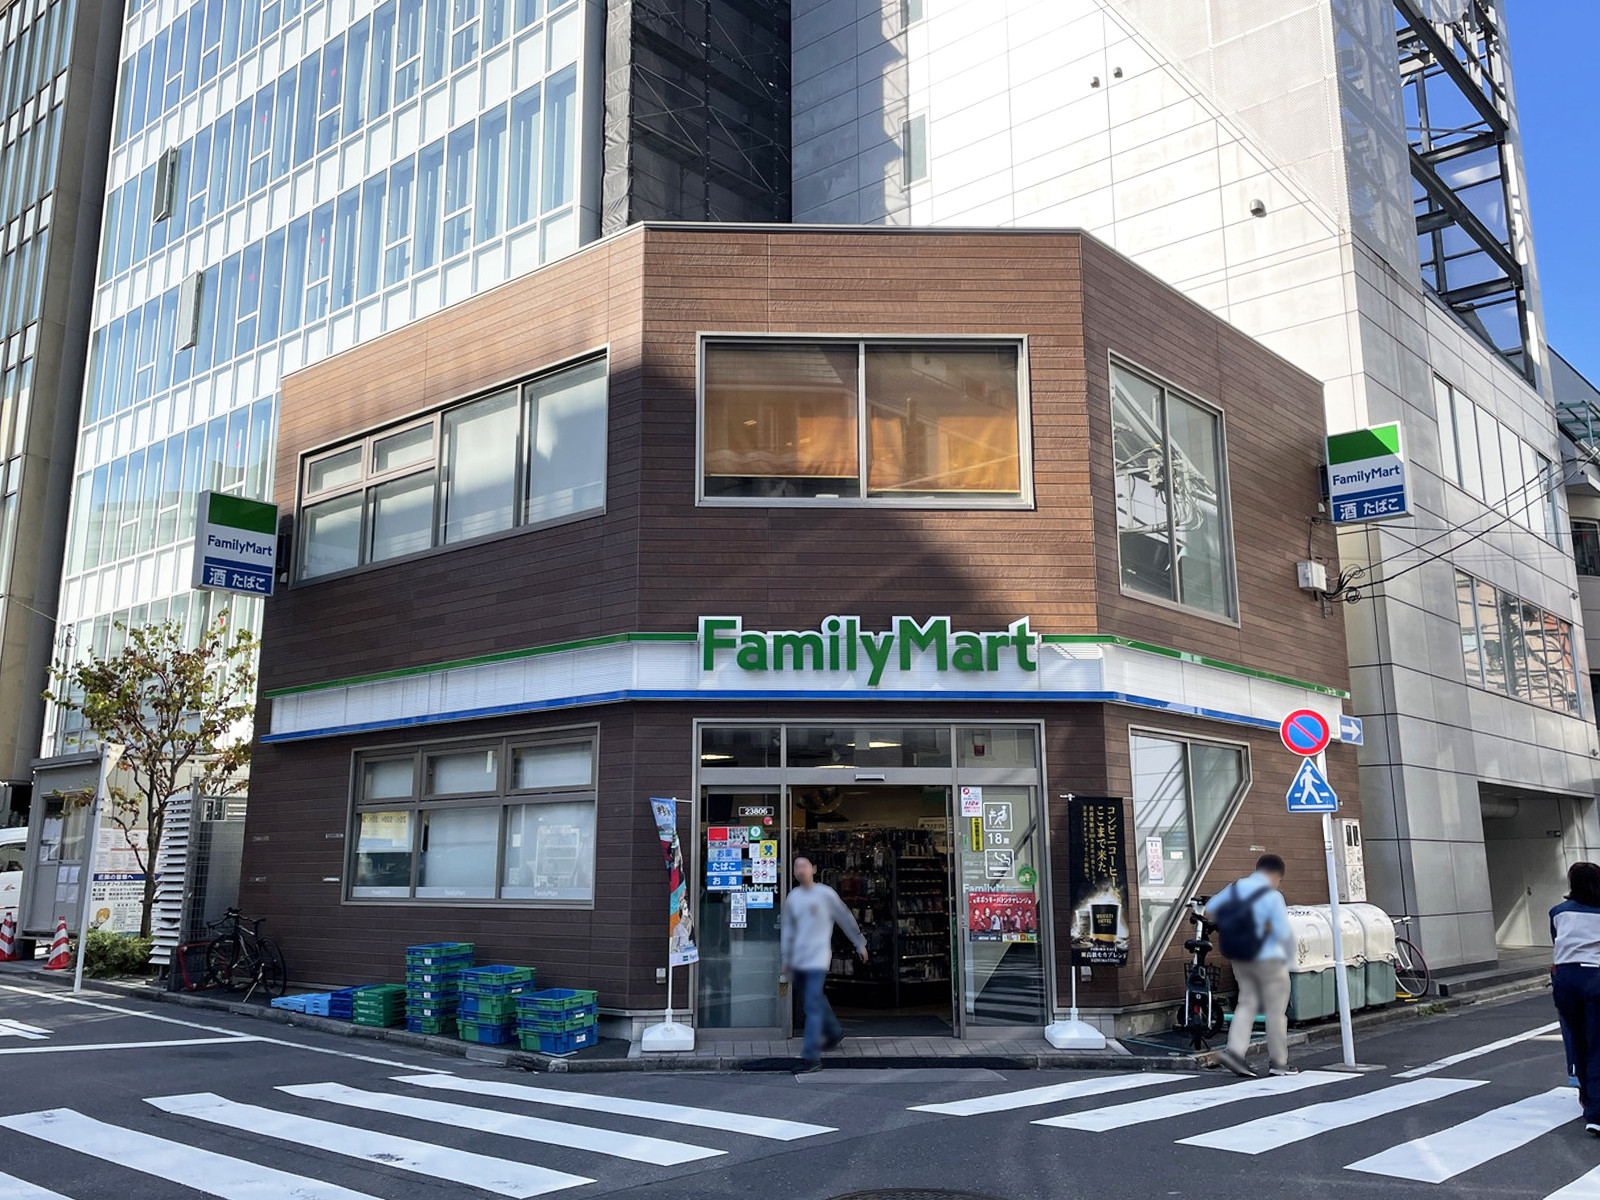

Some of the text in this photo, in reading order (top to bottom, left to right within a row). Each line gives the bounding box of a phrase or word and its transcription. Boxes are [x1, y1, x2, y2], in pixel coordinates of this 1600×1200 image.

[1332, 464, 1400, 486] FamilyMart
[1340, 498, 1399, 520] 酒 たばこ
[207, 534, 273, 557] FamilyMart
[208, 567, 266, 591] 酒 たばこ
[701, 616, 1037, 687] FamilyMart
[744, 807, 768, 815] 23806
[712, 862, 737, 871] たばこ
